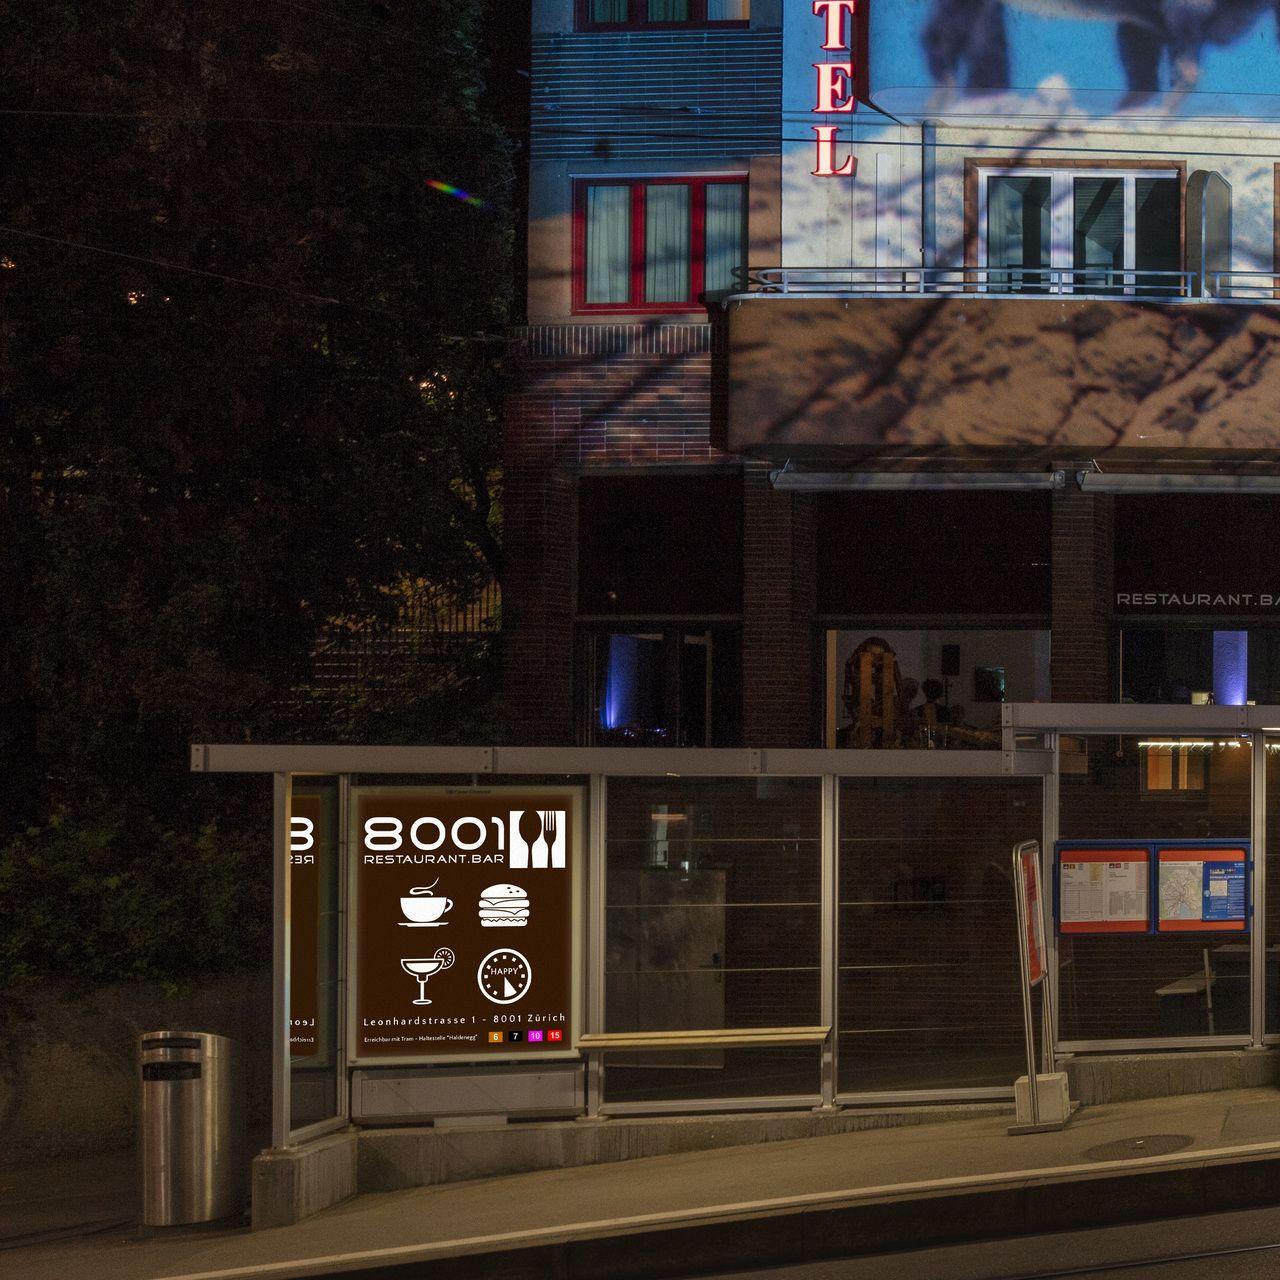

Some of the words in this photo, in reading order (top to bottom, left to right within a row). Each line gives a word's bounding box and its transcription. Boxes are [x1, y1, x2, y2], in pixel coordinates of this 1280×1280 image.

[364, 816, 505, 851] 8001
[364, 854, 504, 864] RESTAURANT.BAR
[490, 967, 519, 976] HAPPY
[363, 1016, 466, 1026] Leonhardstrasse
[471, 1016, 475, 1024] 1
[493, 1014, 522, 1023] 8001
[527, 1013, 566, 1022] Zürich
[493, 1033, 499, 1041] 6
[531, 1032, 540, 1040] 10
[550, 1031, 560, 1039] 15
